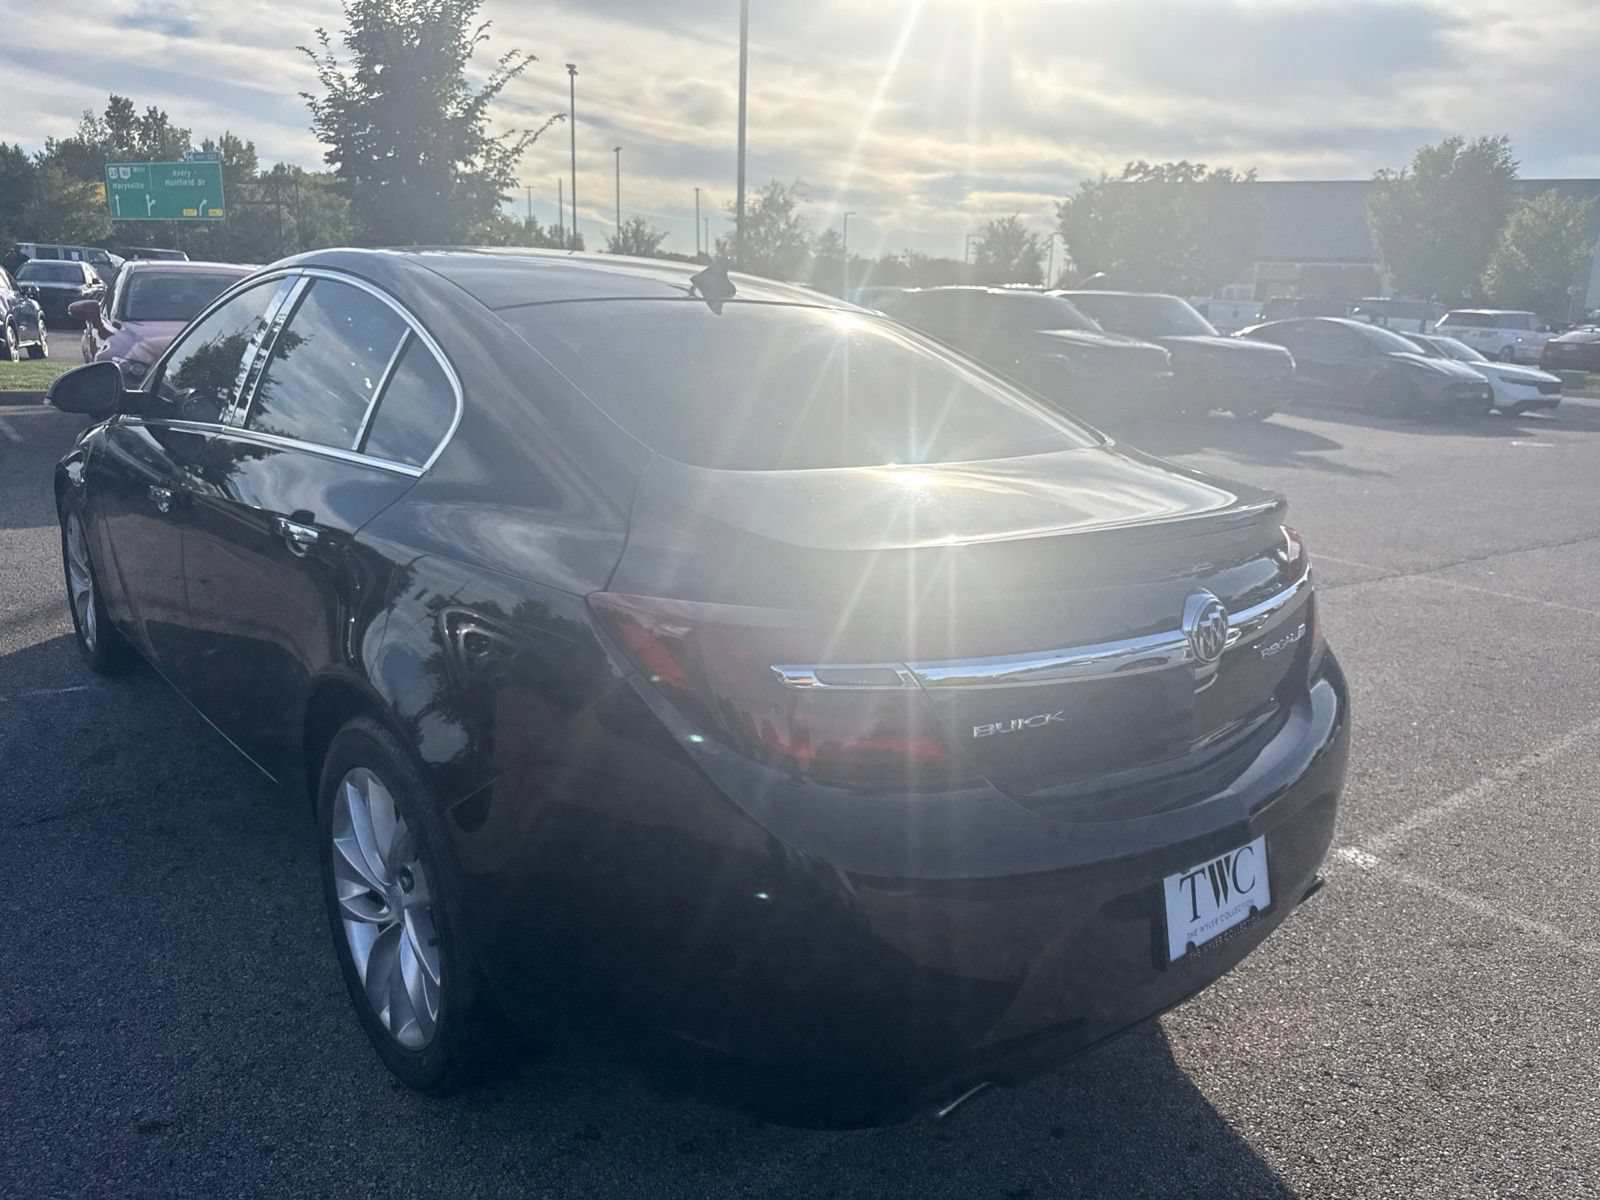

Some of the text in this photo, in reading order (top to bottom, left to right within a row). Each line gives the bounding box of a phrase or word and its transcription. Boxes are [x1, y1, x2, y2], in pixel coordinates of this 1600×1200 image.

[164, 178, 206, 187] Muirfield Dr
[172, 169, 191, 178] Avery
[112, 182, 145, 191] Marysville
[972, 709, 1065, 738] BUICK
[1179, 846, 1255, 923] TWC
[1187, 898, 1255, 939] THE WYLER COLLECTION
